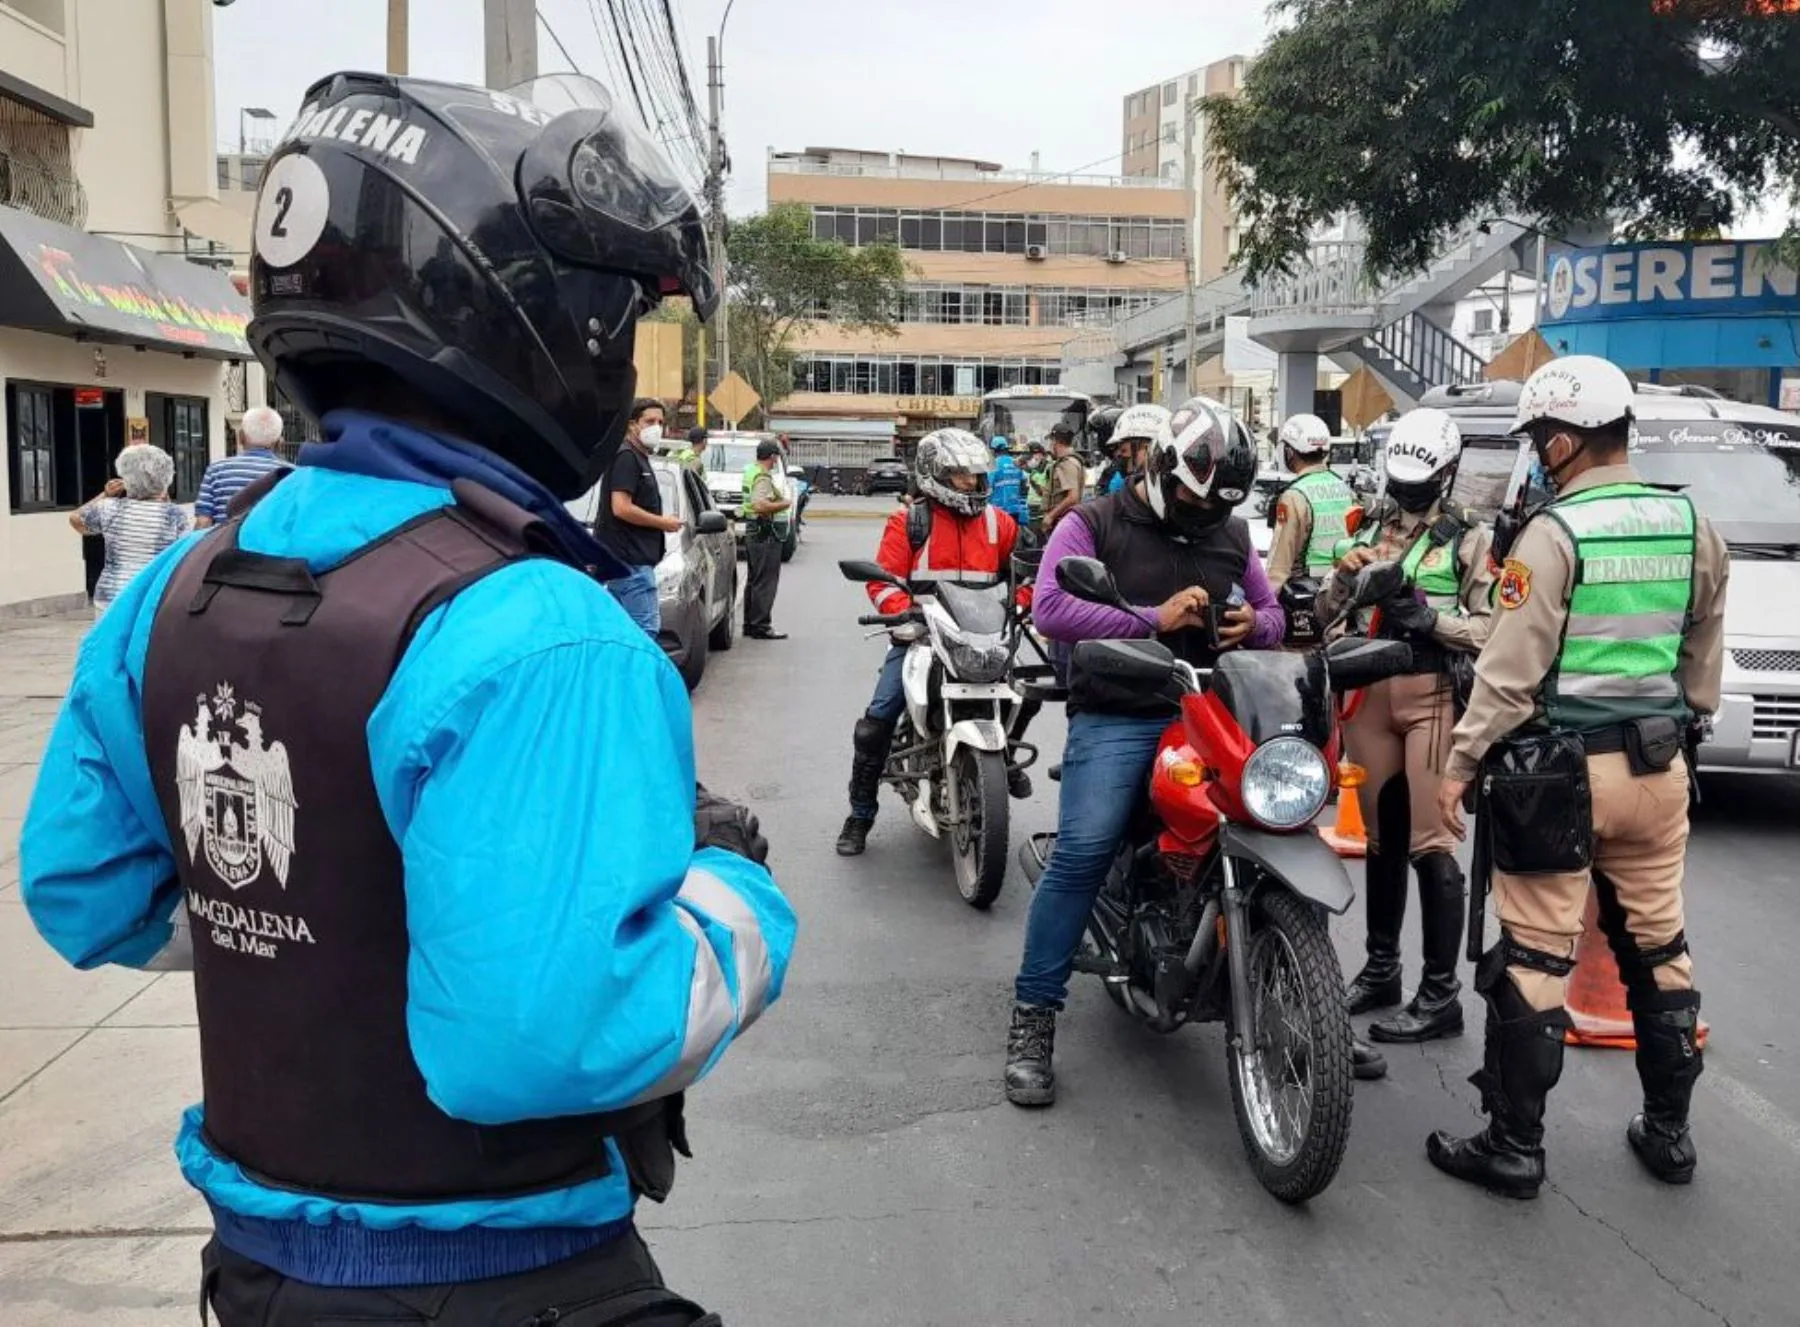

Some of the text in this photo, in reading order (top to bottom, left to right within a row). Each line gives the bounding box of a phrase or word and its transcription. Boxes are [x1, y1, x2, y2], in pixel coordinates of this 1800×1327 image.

[270, 186, 293, 238] 2
[1388, 441, 1438, 469] POLICIA
[1585, 556, 1691, 582] TRANSITO
[187, 887, 316, 944] MAGDALENA
[210, 925, 278, 959] del Mar
